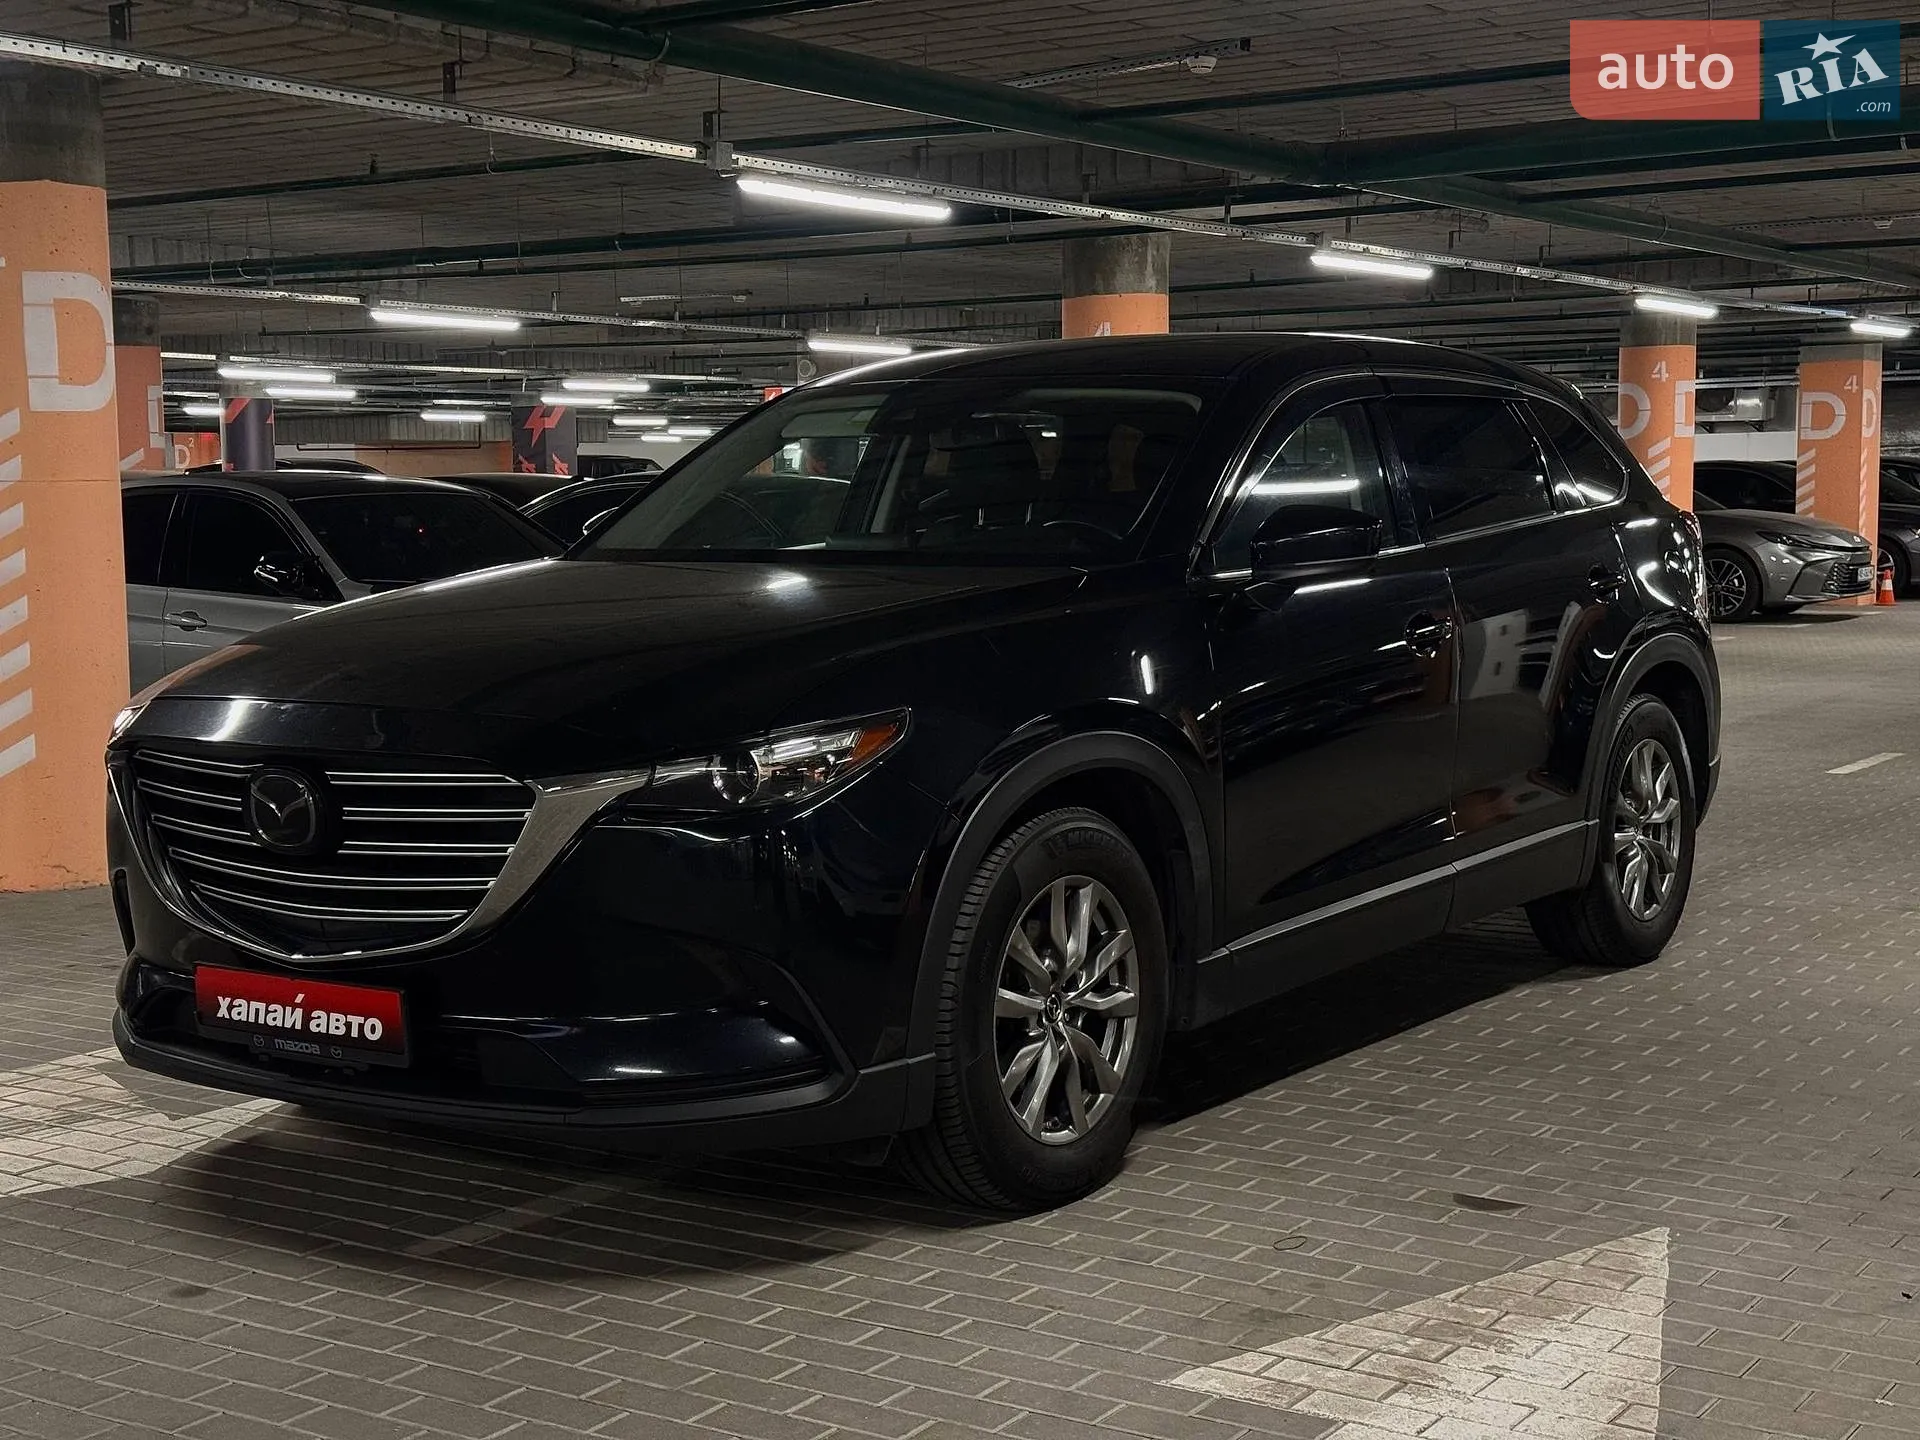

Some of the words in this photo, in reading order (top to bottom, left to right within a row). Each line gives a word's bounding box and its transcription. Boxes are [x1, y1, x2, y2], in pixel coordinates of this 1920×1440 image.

[22, 271, 115, 412] D
[1652, 361, 1669, 382] 4
[1801, 392, 1847, 440] D
[1844, 375, 1859, 393] 4
[174, 444, 191, 468] D
[309, 1010, 383, 1041] авто
